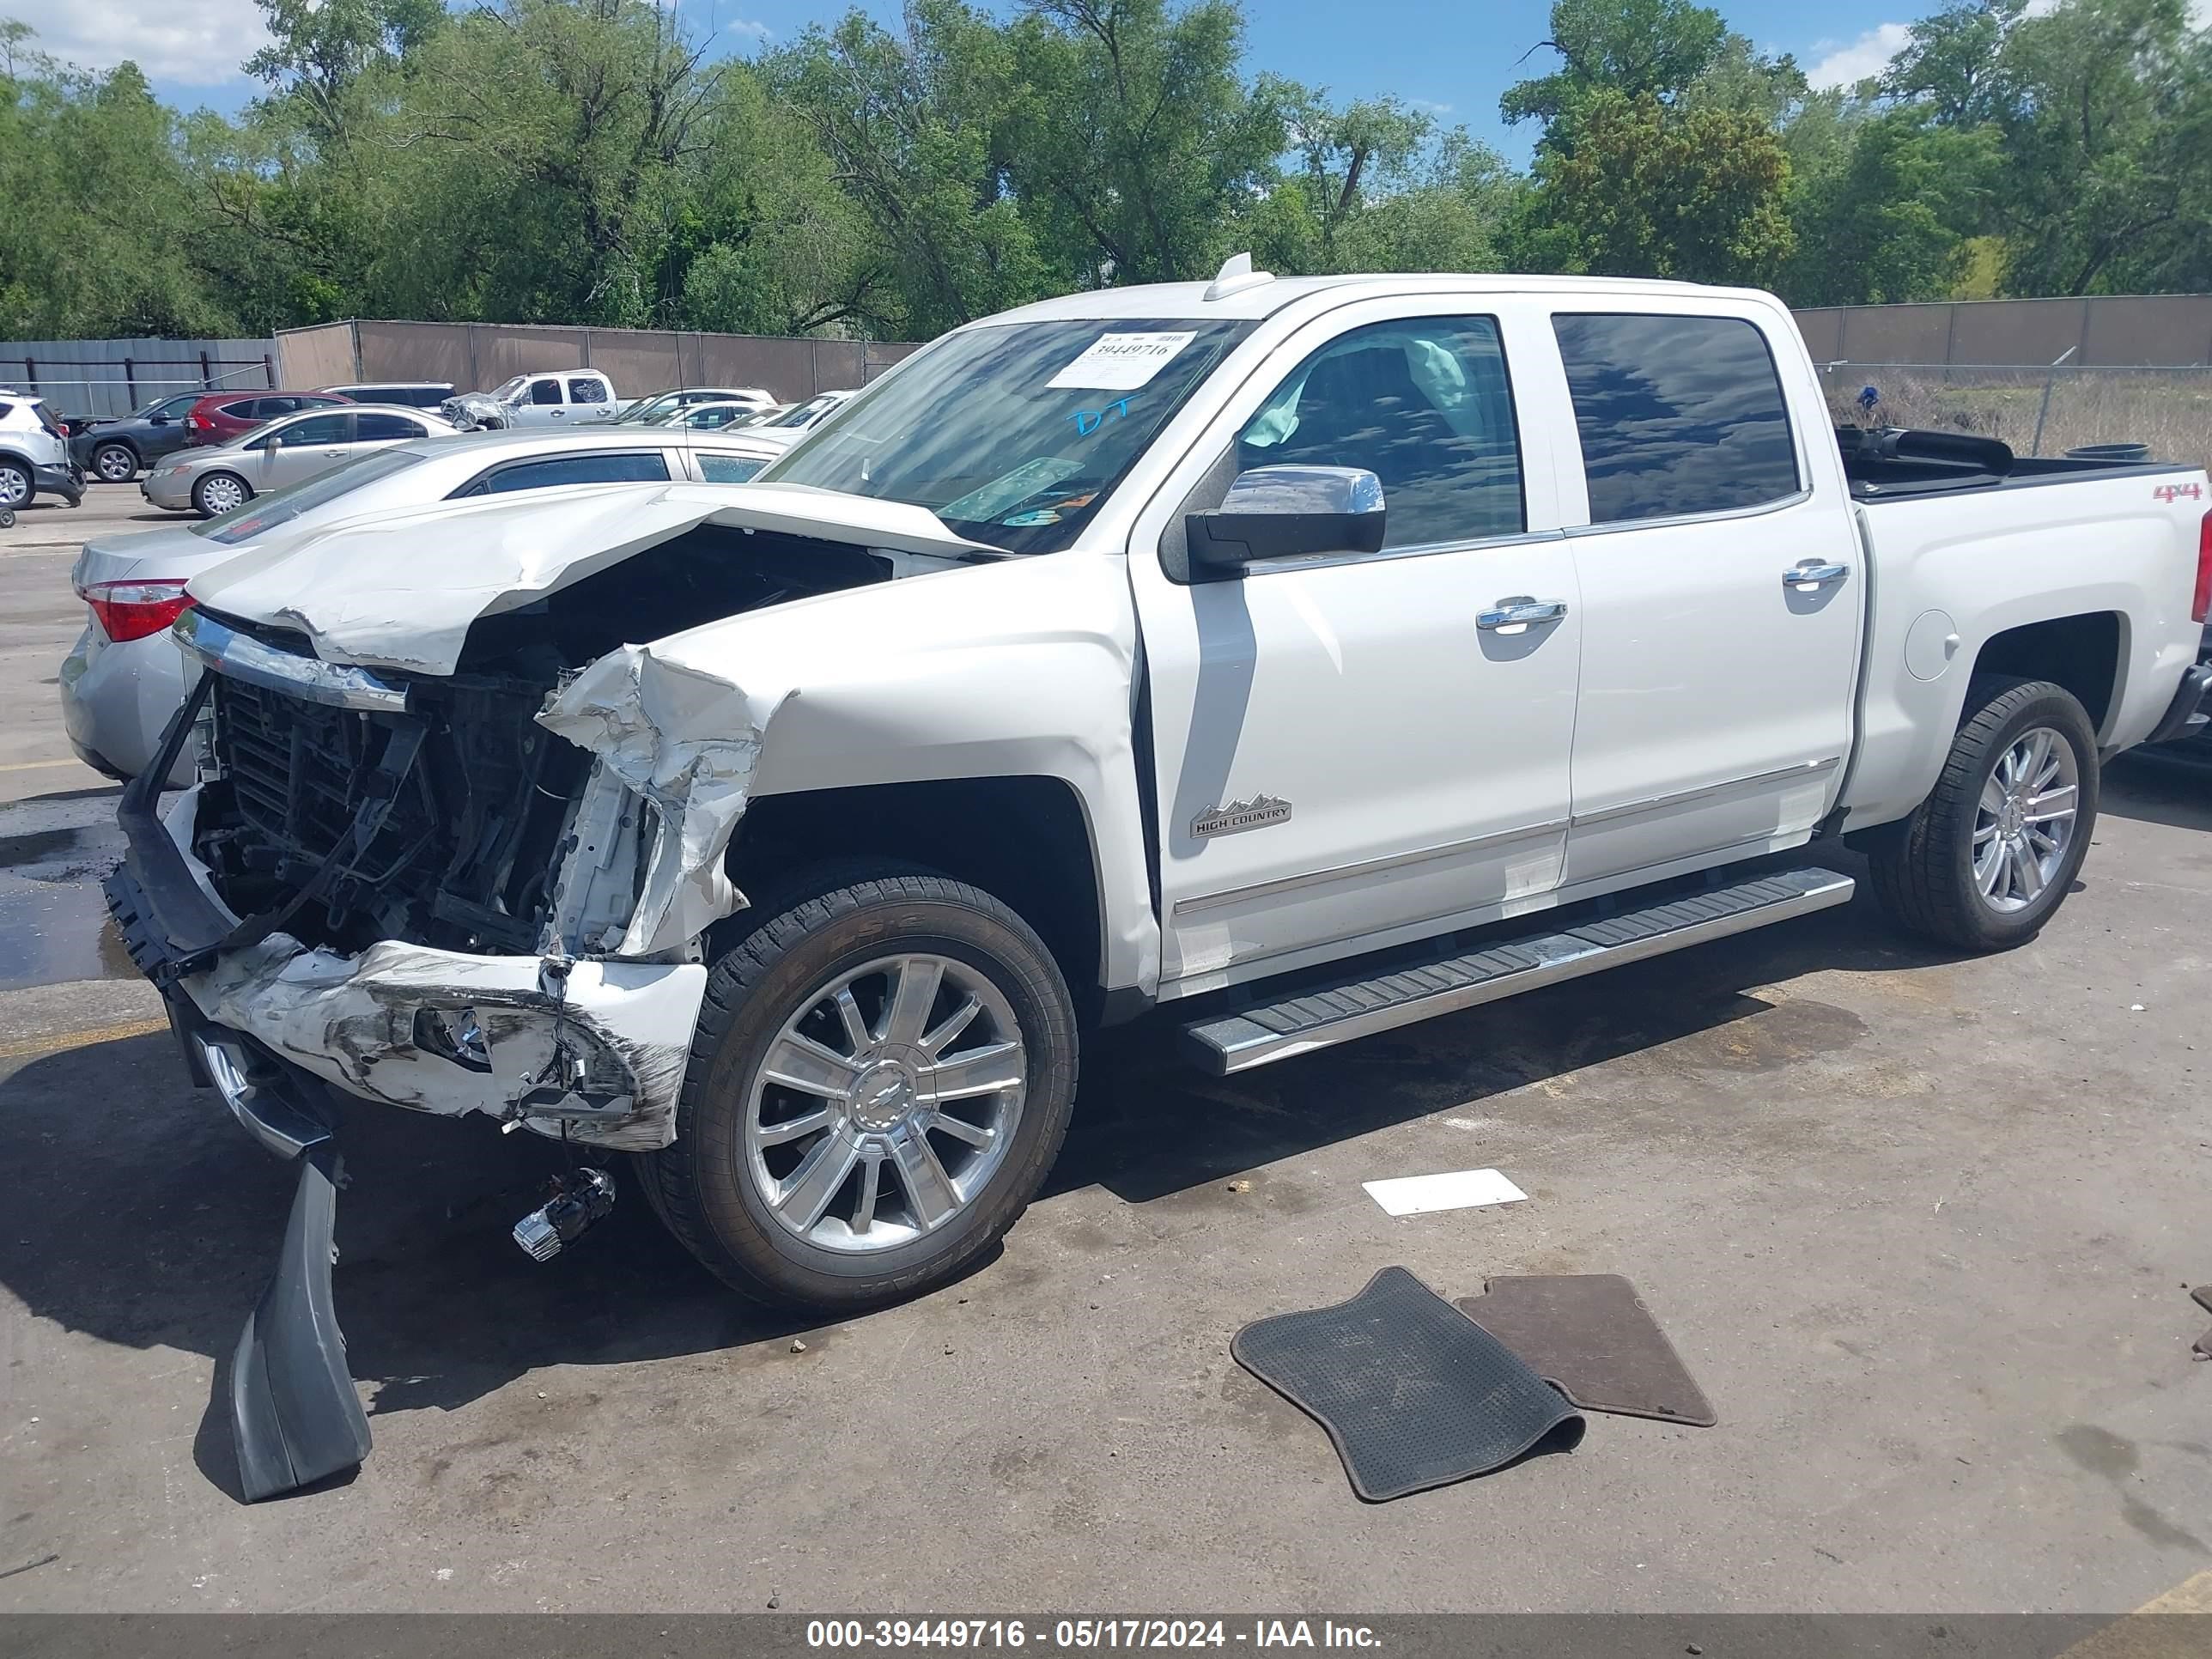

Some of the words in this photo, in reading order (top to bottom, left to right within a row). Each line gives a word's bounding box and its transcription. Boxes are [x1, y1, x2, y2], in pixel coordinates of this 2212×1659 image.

[1091, 344, 1170, 356] 39449716
[1196, 819, 1228, 833] HIGH
[1231, 808, 1289, 826] COUNTRY
